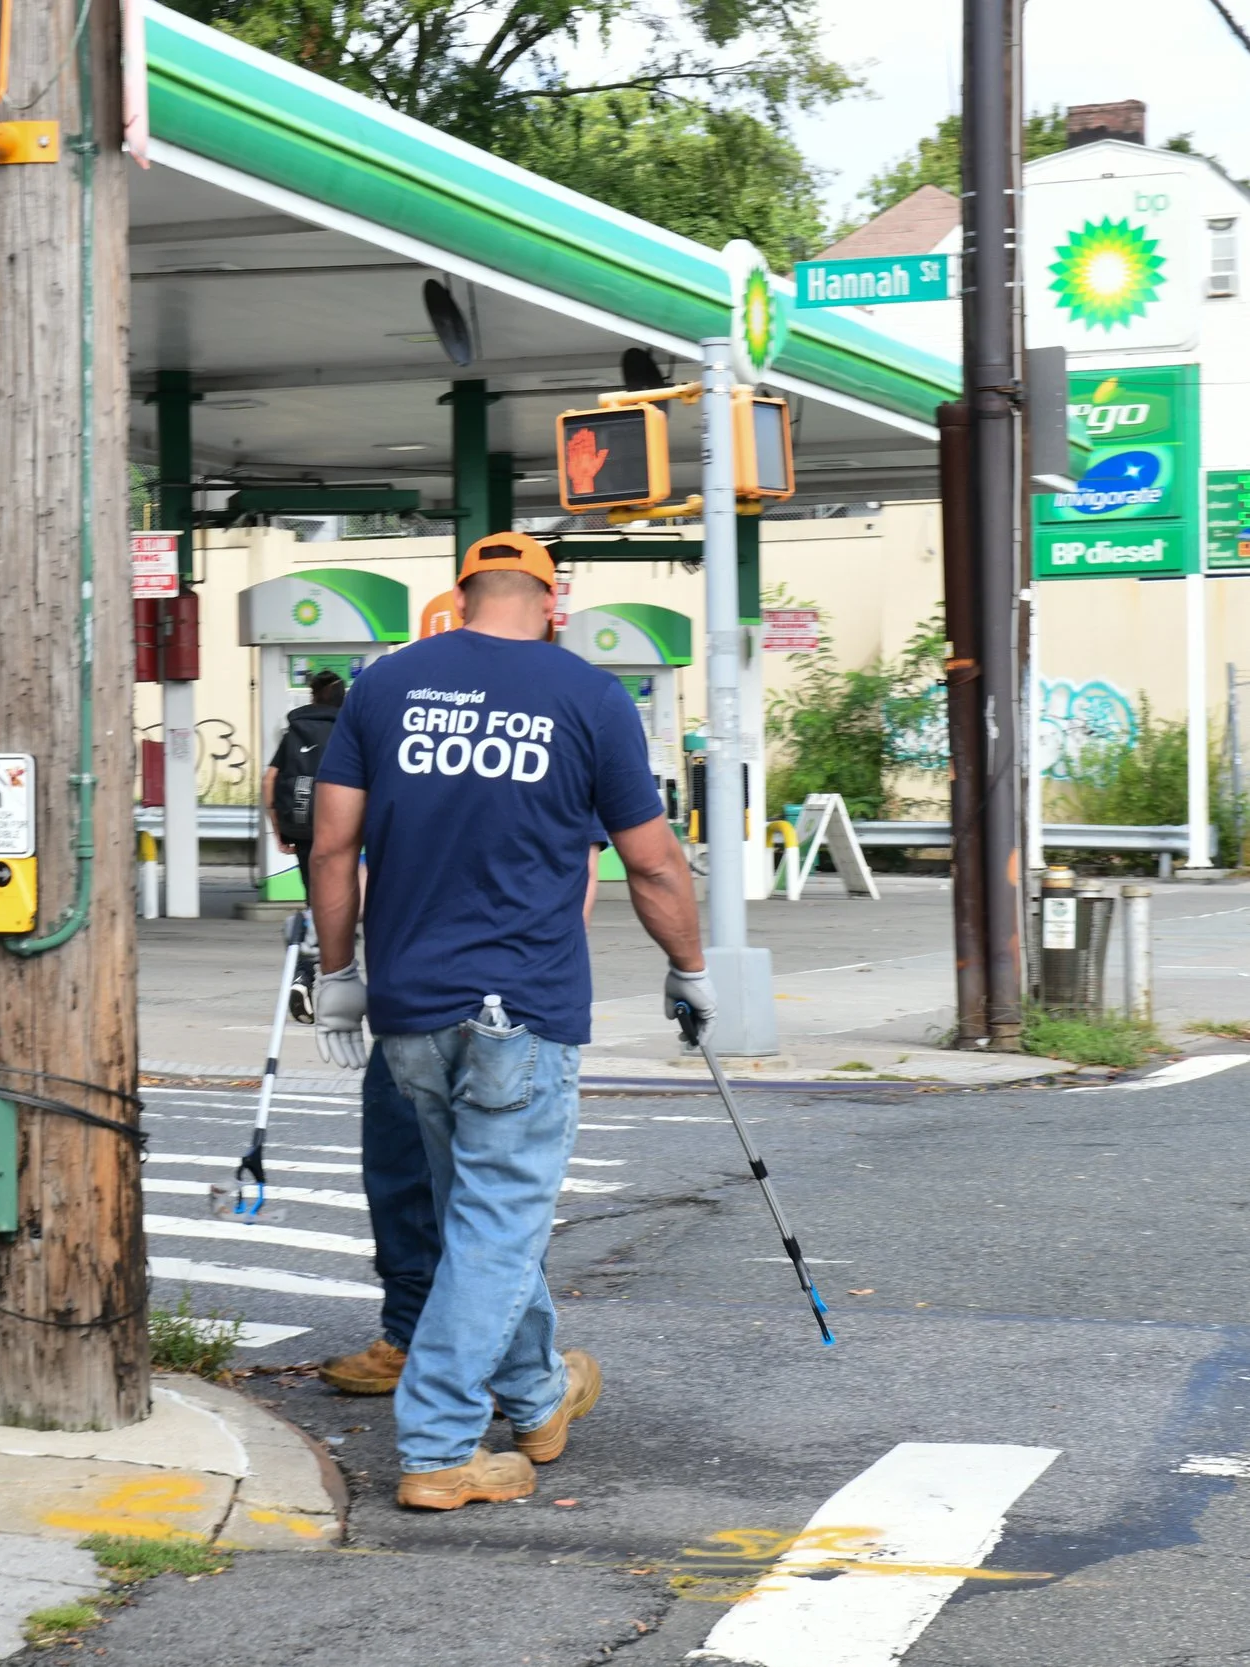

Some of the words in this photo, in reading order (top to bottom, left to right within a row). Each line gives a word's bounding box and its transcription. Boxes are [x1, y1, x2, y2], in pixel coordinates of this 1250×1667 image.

[1134, 190, 1170, 217] bp
[807, 264, 910, 301] Hannah
[919, 261, 941, 282] St
[406, 688, 486, 706] nationalgrid
[402, 706, 479, 734] GRID
[486, 711, 554, 743] FOR
[398, 734, 549, 782] GOOD
